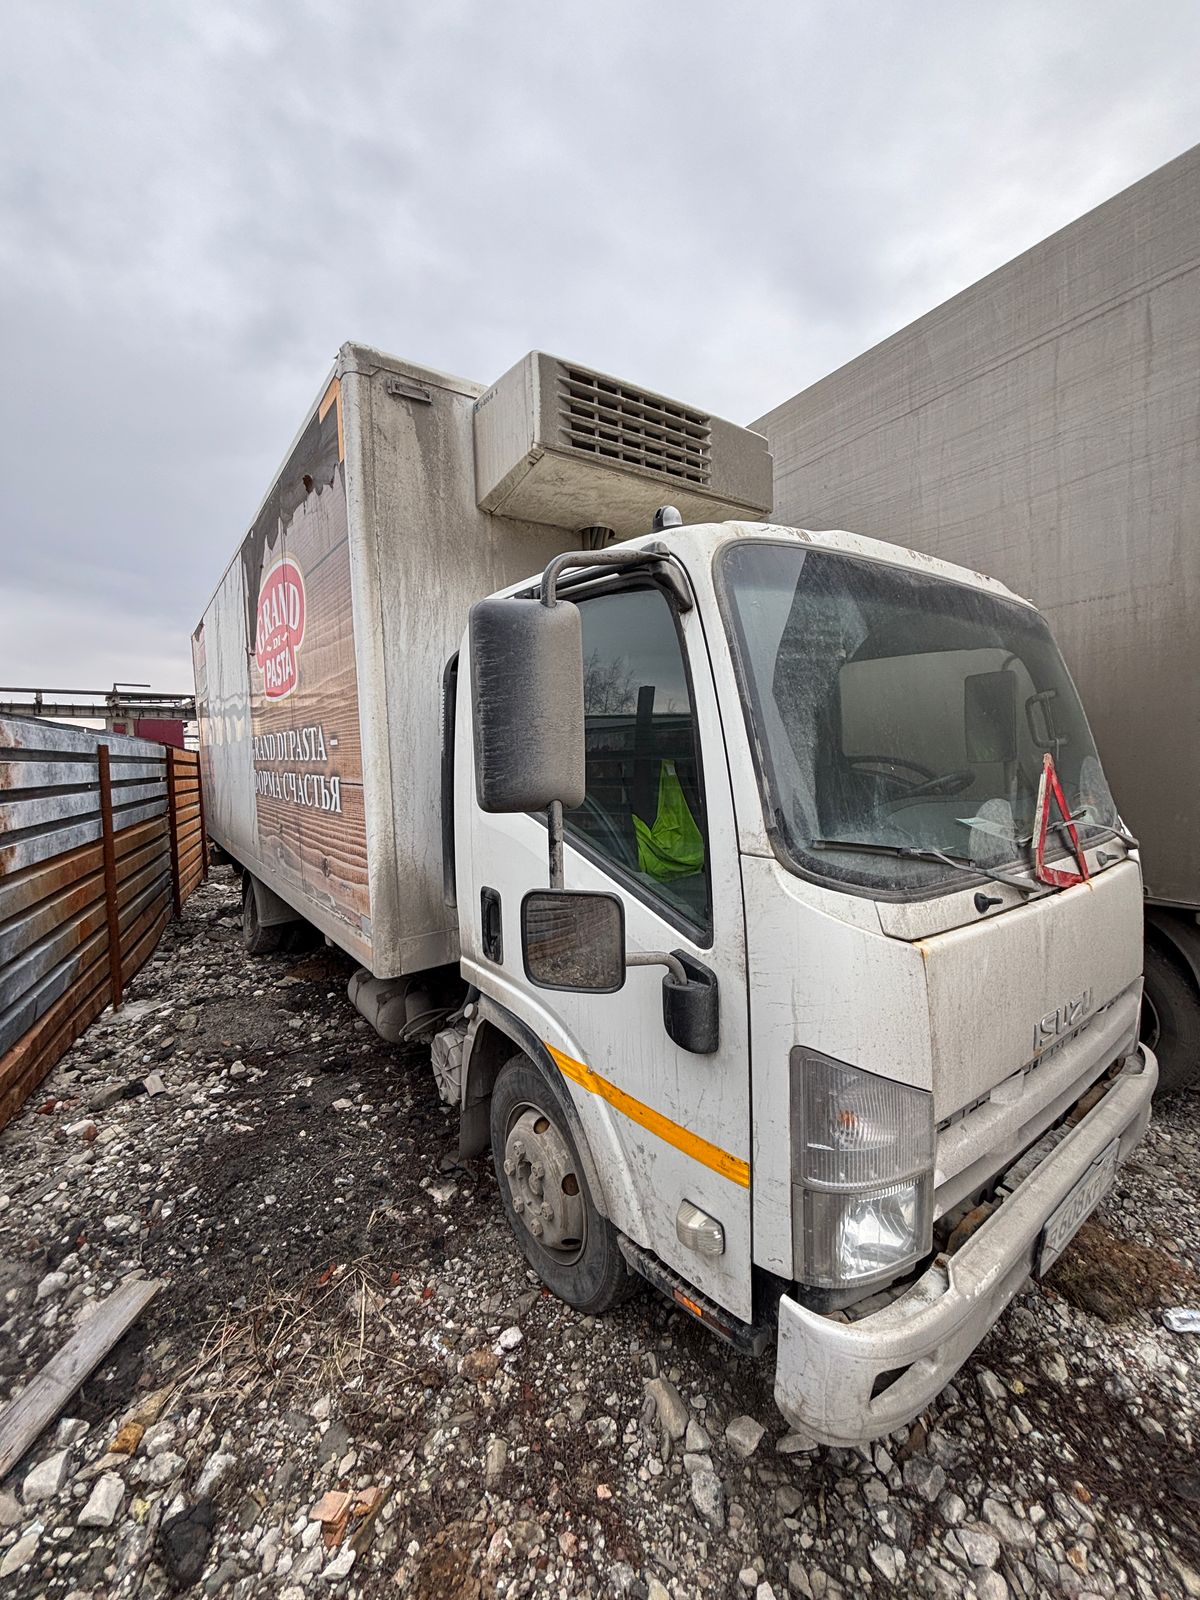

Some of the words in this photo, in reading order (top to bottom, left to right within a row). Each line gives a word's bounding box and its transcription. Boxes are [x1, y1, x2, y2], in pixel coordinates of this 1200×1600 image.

[256, 582, 300, 655] GRAND
[273, 635, 281, 649] DI
[266, 646, 293, 688] PASTA
[277, 732, 288, 761] DI
[289, 725, 327, 762] PASTA
[283, 772, 342, 813] СЧАСТЬЯ
[1033, 986, 1093, 1053] ISUZU
